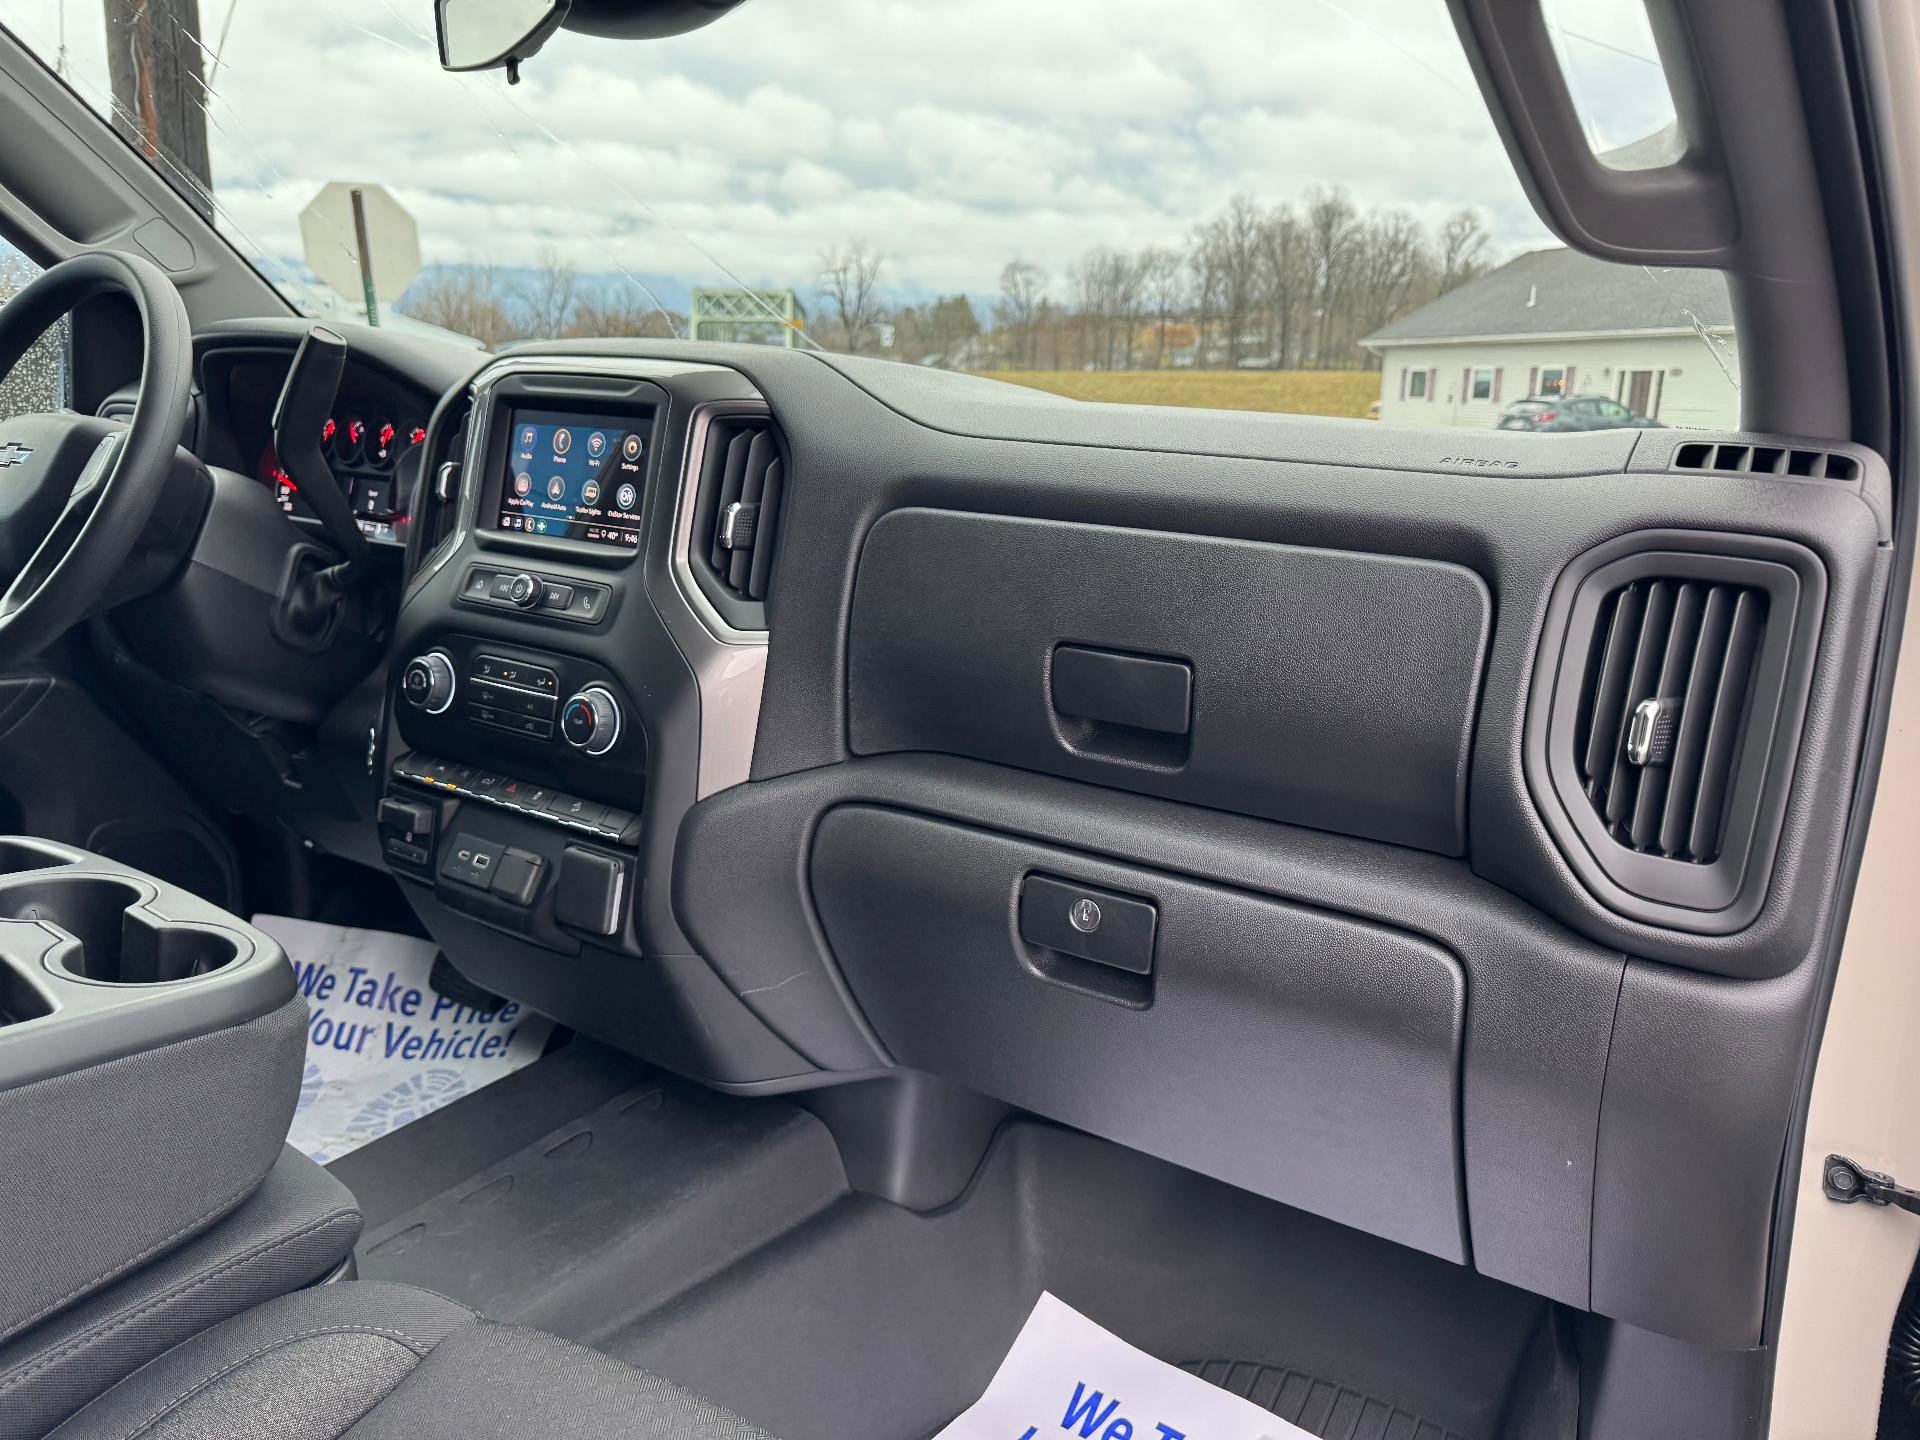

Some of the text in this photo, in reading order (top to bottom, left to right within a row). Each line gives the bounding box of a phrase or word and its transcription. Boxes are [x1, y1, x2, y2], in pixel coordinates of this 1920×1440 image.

[1439, 457, 1519, 469] AIRBAG
[294, 961, 336, 1000] We
[344, 966, 422, 1018] Take
[384, 1021, 518, 1061] Vehicle!
[1060, 1381, 1133, 1440] We
